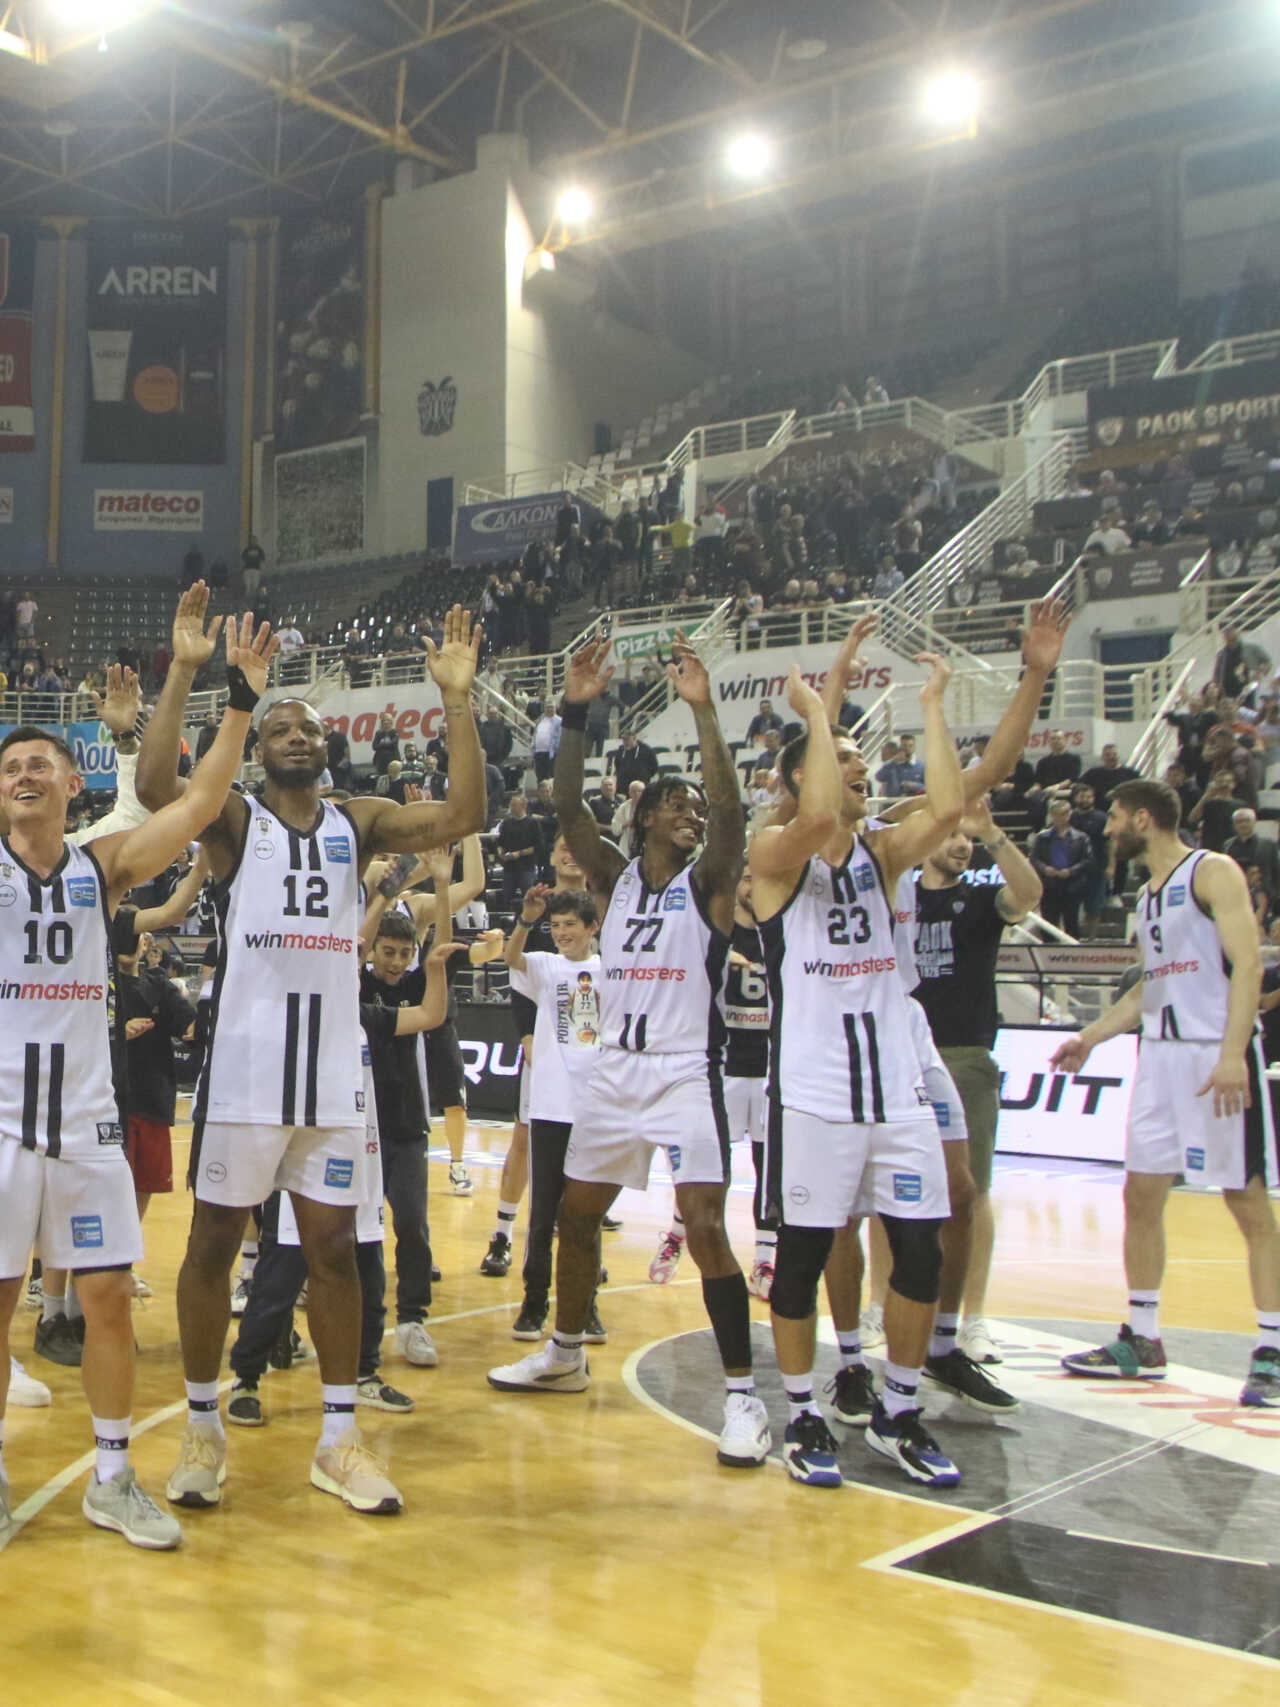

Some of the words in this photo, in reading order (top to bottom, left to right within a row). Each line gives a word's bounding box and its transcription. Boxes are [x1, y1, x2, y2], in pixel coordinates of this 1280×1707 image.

[1136, 408, 1200, 440] PAOK
[98, 493, 201, 514] mateco
[619, 629, 671, 656] PIZZA
[719, 665, 893, 702] winmasers
[283, 874, 330, 918] 12
[23, 919, 74, 965] 10
[244, 929, 354, 954] winmasters
[622, 917, 665, 953] 77
[827, 906, 872, 946] 23
[740, 962, 768, 1000] 6
[803, 956, 897, 978] winmasters
